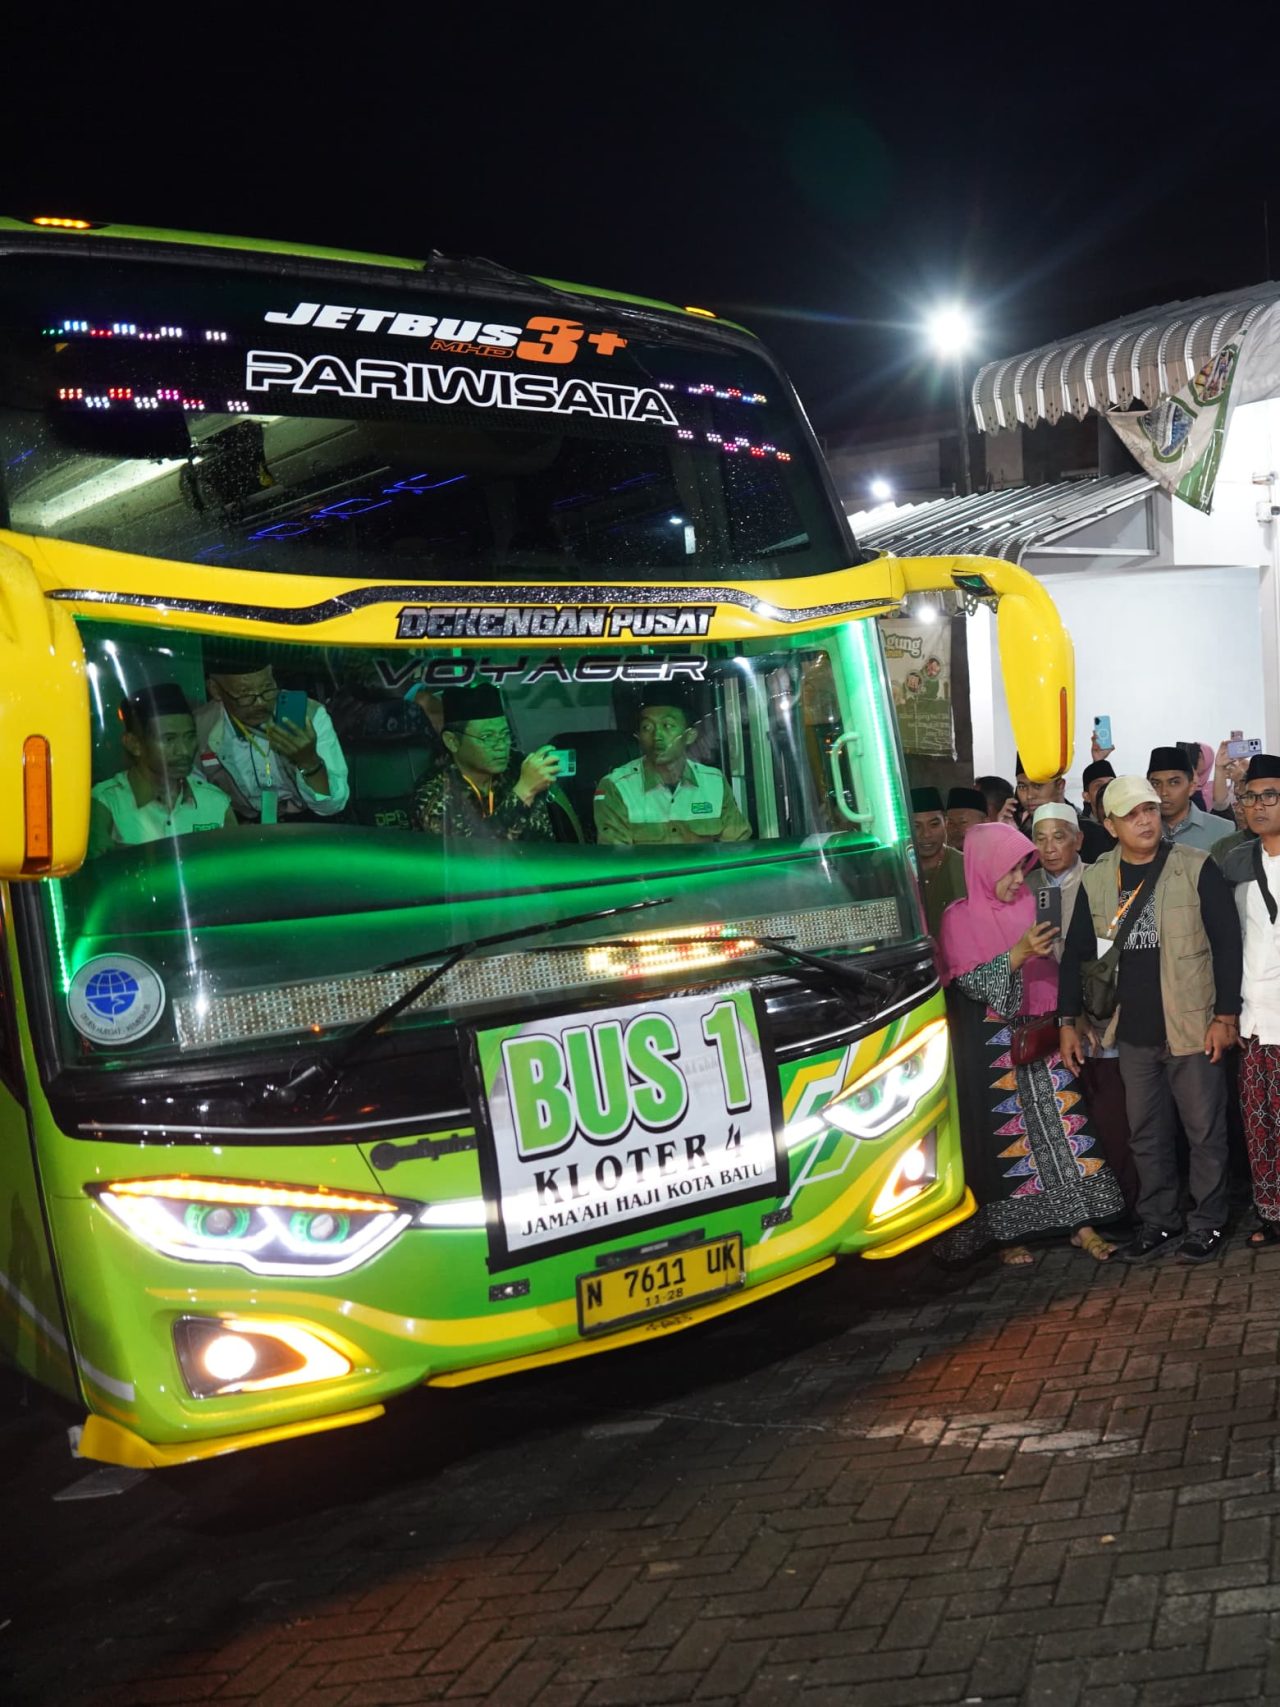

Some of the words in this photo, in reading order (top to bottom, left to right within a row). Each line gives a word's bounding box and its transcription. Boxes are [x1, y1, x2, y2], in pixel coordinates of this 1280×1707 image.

[264, 302, 523, 347] JETBUS
[430, 338, 515, 360] MHD
[246, 349, 679, 426] PARIWISATA
[396, 606, 608, 640] DEKENGAN
[607, 605, 716, 638] PUSAT
[883, 630, 922, 659] gung
[373, 653, 708, 690] VOYAGER
[503, 1012, 687, 1160] BUS
[701, 1000, 751, 1113] 1
[533, 1133, 711, 1207] KLOTER
[725, 1122, 745, 1158] 4
[521, 1202, 609, 1236] JAMA'AH
[616, 1188, 661, 1213] HAJI
[667, 1176, 715, 1198] KOTA
[720, 1162, 763, 1186] BATU
[587, 1280, 603, 1310] N
[624, 1258, 686, 1298] 7611
[707, 1243, 736, 1274] UK
